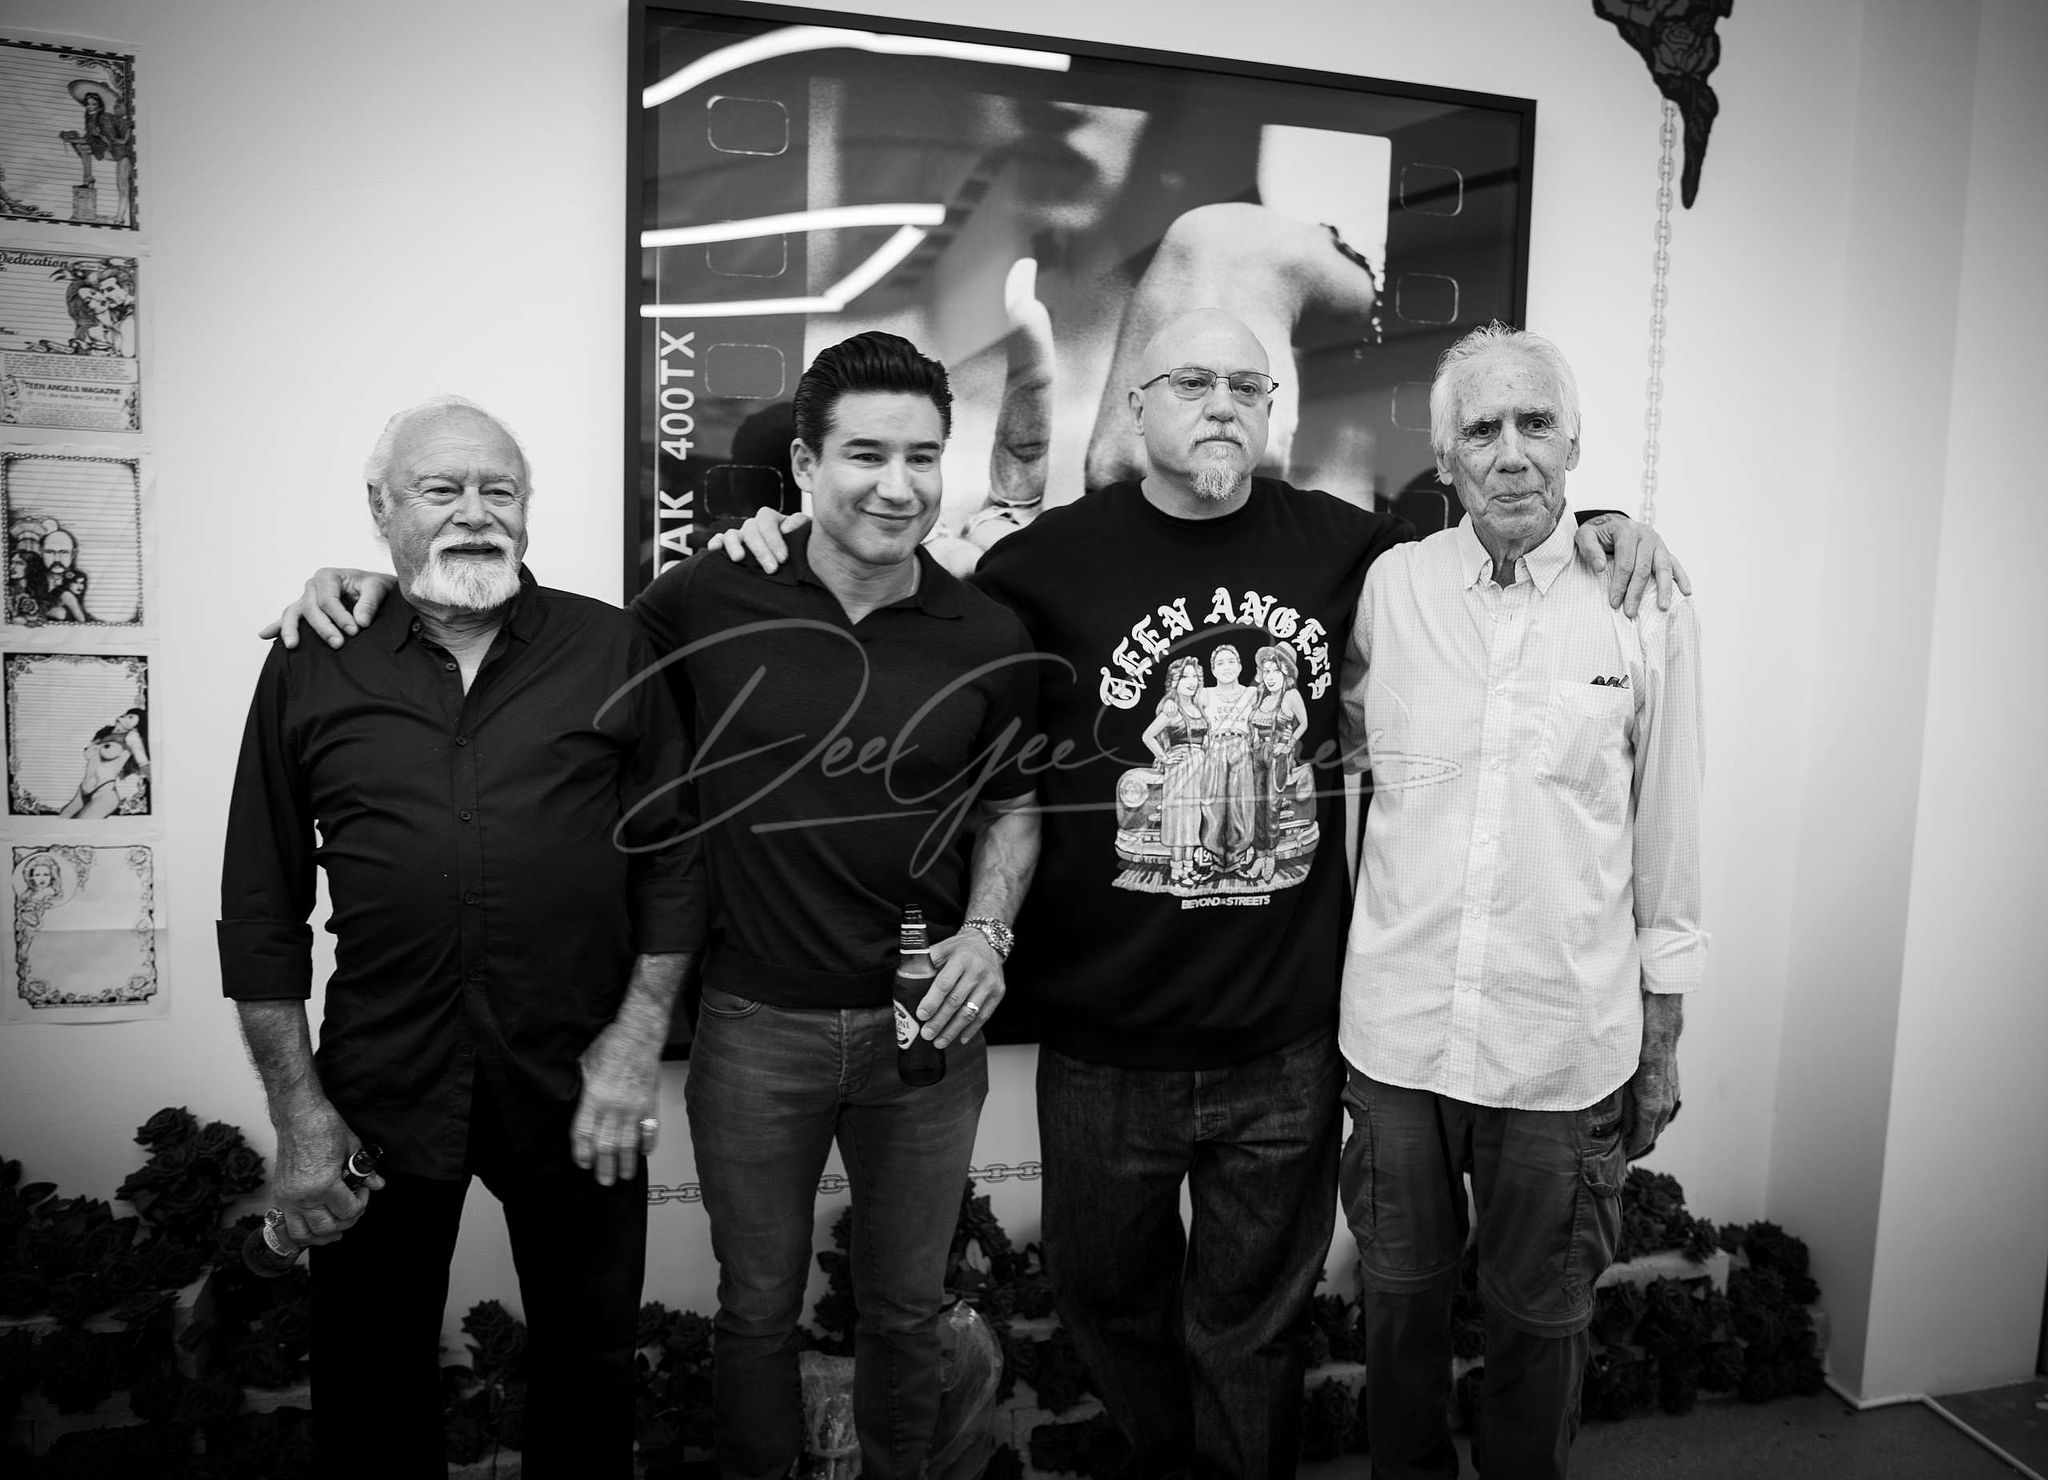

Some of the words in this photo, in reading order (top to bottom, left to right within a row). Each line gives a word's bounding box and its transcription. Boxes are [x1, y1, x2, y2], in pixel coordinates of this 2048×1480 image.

[47, 384, 80, 393] ANGELS
[81, 386, 122, 396] MAGAZINE
[659, 330, 695, 461] 400TX
[1100, 597, 1194, 709] TEEN
[1204, 587, 1332, 699] ANGELS
[1181, 897, 1221, 910] BEYOND
[1226, 895, 1271, 906] STREETS
